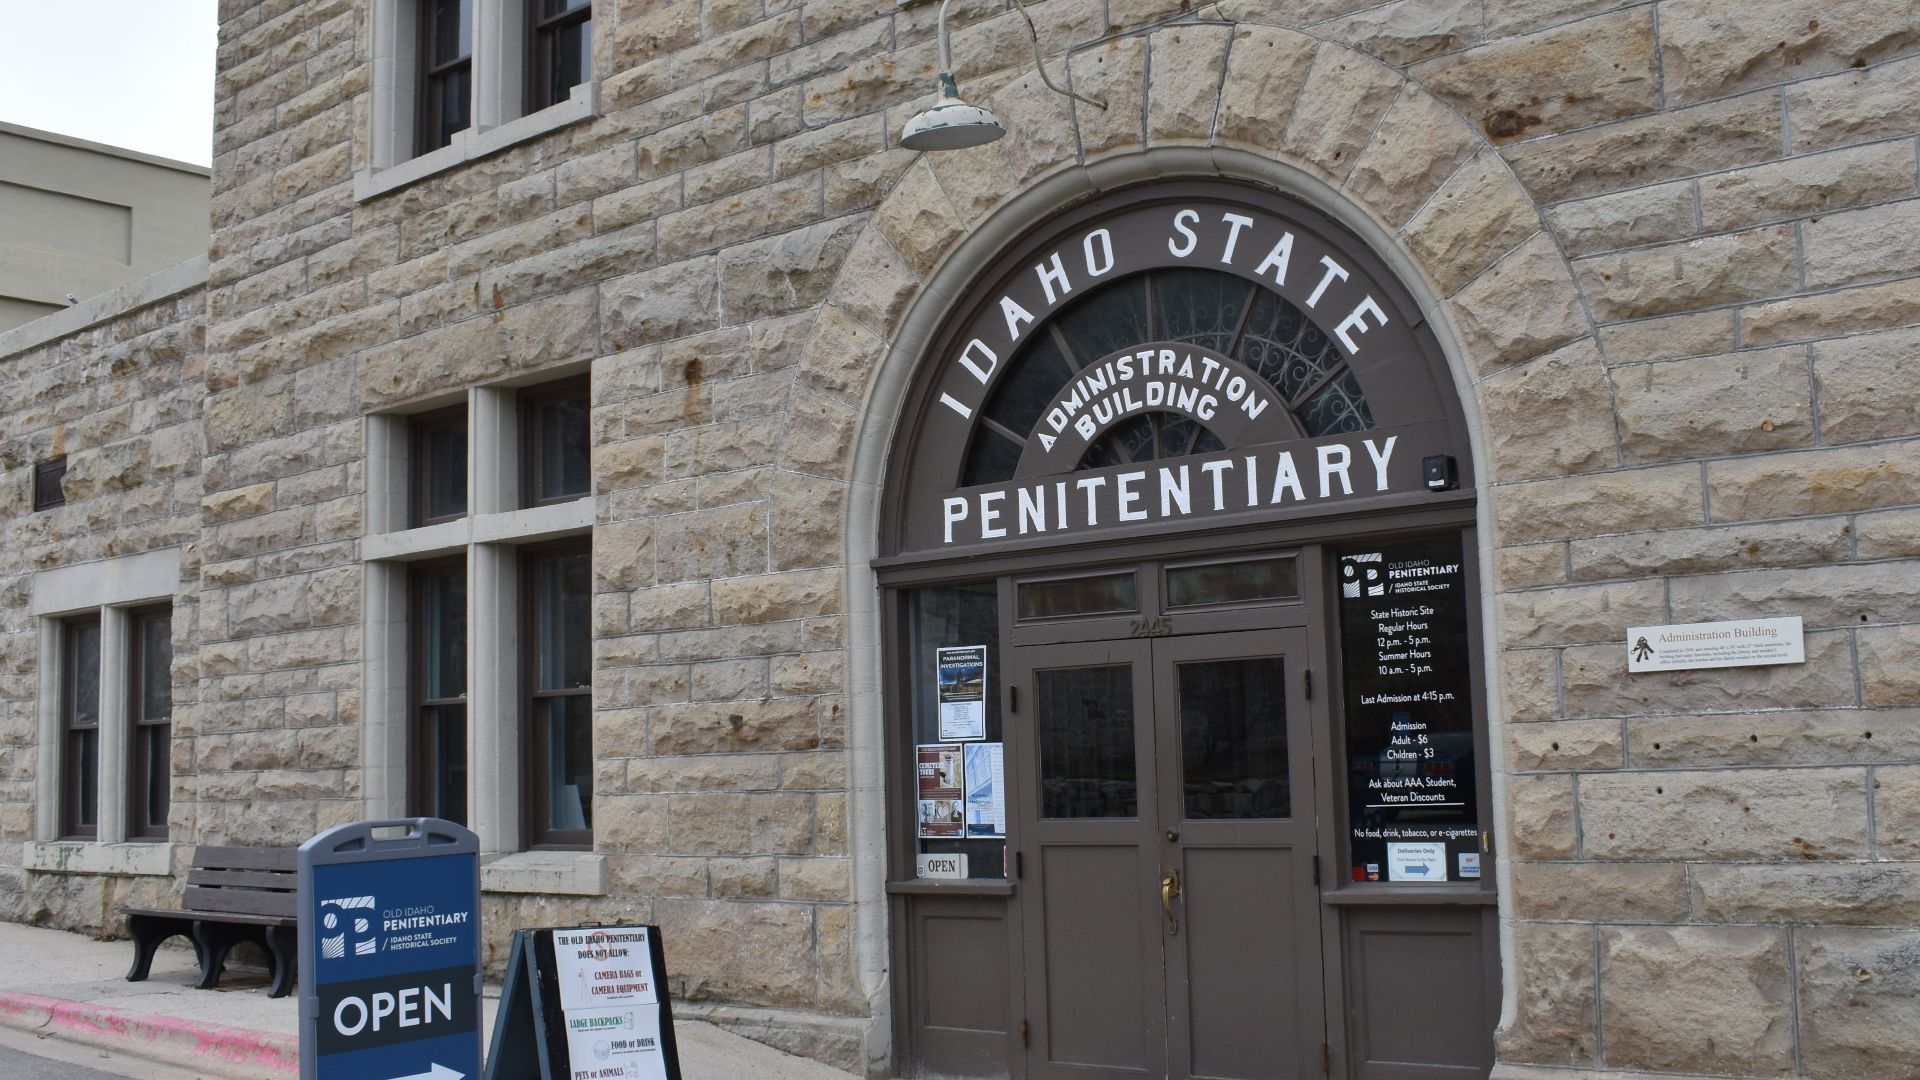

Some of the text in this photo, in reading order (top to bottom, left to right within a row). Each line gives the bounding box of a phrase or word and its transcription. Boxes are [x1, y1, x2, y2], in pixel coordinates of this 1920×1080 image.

[939, 209, 1389, 420] IDAHO STATE
[1037, 349, 1269, 452] ADMINISTRATION
[1074, 381, 1218, 441] BUILDING
[943, 436, 1398, 543] PENITENTIARY
[1388, 559, 1430, 570] OLD IDAHO
[1389, 564, 1459, 579] PENITENTIARY
[1395, 583, 1451, 594] HISTORICAL SOCIETY
[1370, 605, 1434, 620] State Historic Site
[1378, 621, 1428, 636] Regular Hours
[1659, 626, 1778, 643] Administration Building
[1377, 637, 1386, 647] 12
[1386, 640, 1402, 649] p.m.
[1408, 635, 1414, 645] 5
[1415, 638, 1431, 647] p.m.
[1378, 649, 1432, 661] Summer Hours
[940, 661, 983, 669] INVESTIGATIONS
[1378, 665, 1388, 675] 10
[1388, 667, 1404, 675] a.m.
[1410, 663, 1416, 674] 5
[1417, 666, 1433, 676] p.m.
[1360, 690, 1455, 705] Last Admission at 4:15 p.m.
[1390, 721, 1427, 731] Admission
[1391, 735, 1411, 745] Adult
[1417, 734, 1428, 745] $6
[1386, 749, 1417, 760] Children
[1423, 747, 1434, 759] $3
[1368, 776, 1457, 789] Ask about AAA, Student,
[1380, 791, 1446, 803] Veteran Discounts
[1354, 828, 1364, 837] No
[1365, 828, 1382, 838] food,
[1382, 827, 1401, 839] drink,
[1401, 827, 1429, 838] tobacco,
[1438, 827, 1478, 840] e-cigarettes
[928, 859, 956, 872] OPEN
[383, 905, 434, 919] OLD IDAHO
[383, 911, 468, 931] PENITENTIARY
[390, 932, 433, 944] IDAHO STATE
[390, 936, 457, 951] HISTORICAL SOCIETY
[558, 933, 646, 945] THE OLD IDAHO PENITENTIARY
[578, 948, 630, 959] DOES NOT ALLOW:
[594, 969, 642, 980] CAMERA BAGS or
[591, 983, 649, 995] CAMERA EQUIPMENT
[334, 983, 452, 1036] OPEN
[569, 1018, 588, 1029] LARGE
[589, 1016, 624, 1027] BACKPACKS
[611, 1037, 656, 1050] FOOD or DRINK
[575, 1067, 625, 1080] PETS or ANIMALS
